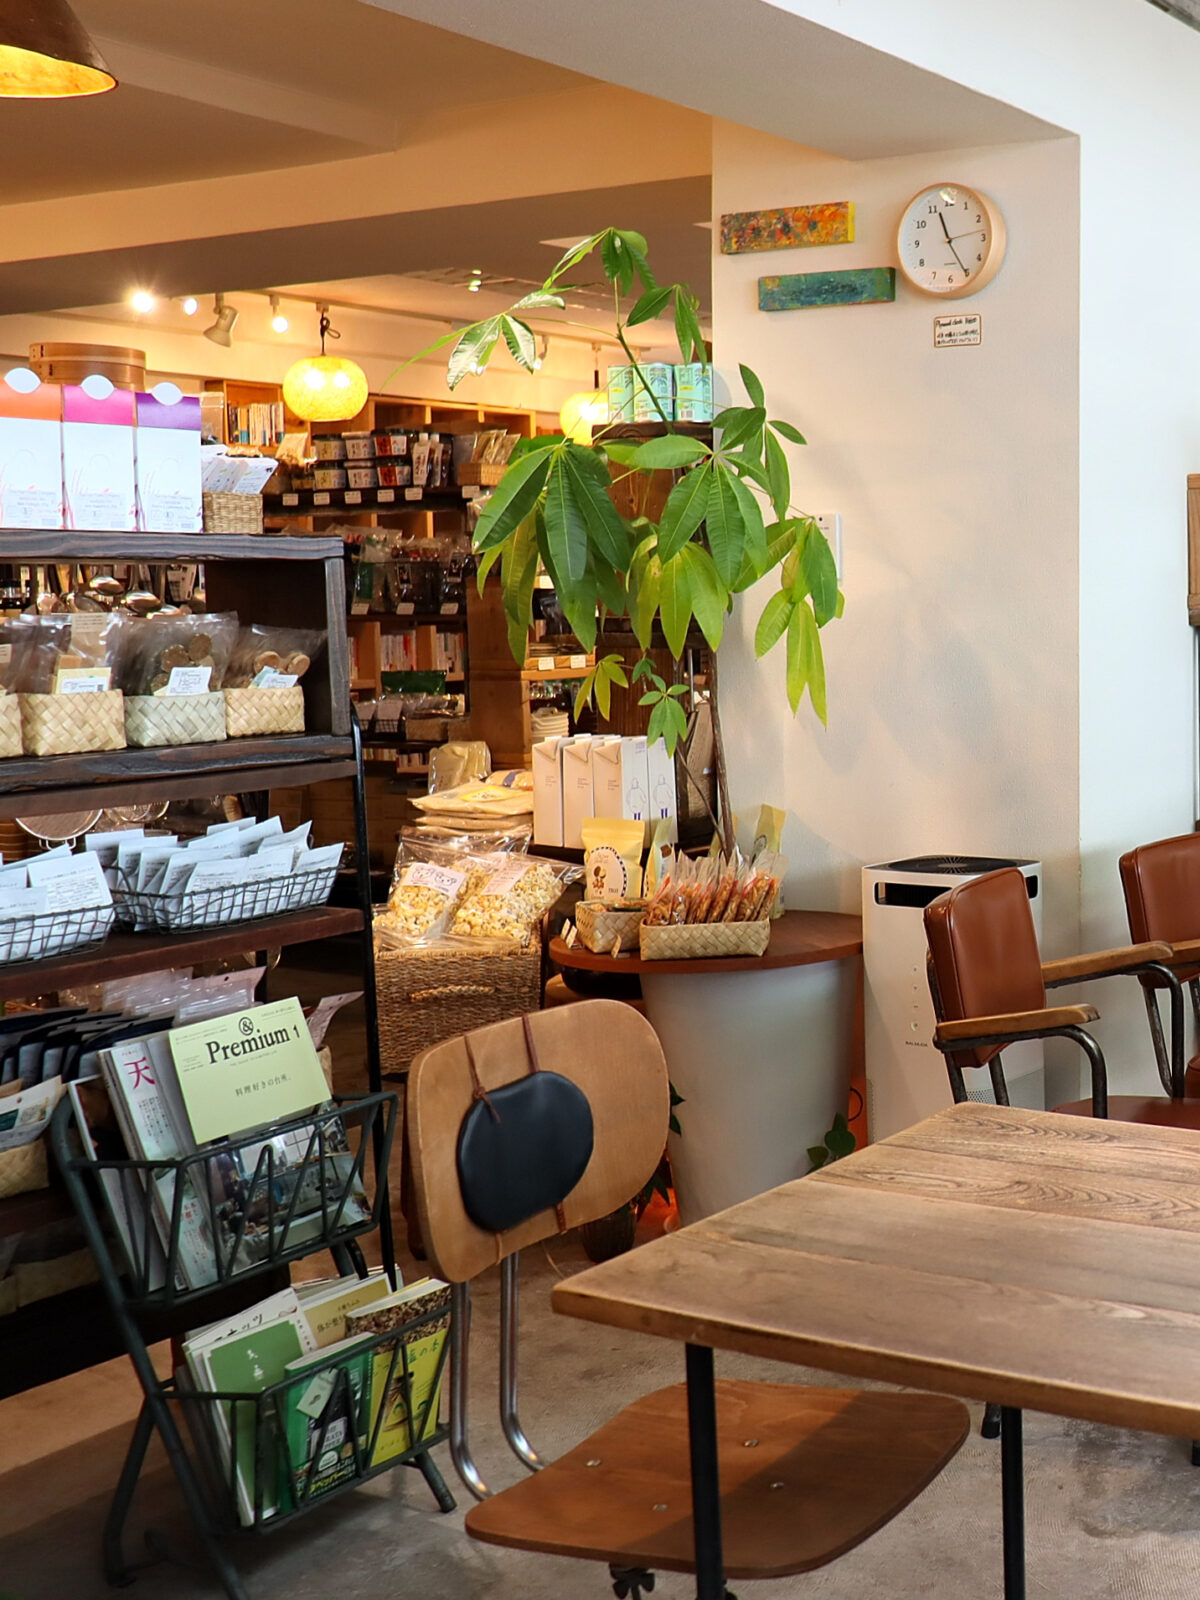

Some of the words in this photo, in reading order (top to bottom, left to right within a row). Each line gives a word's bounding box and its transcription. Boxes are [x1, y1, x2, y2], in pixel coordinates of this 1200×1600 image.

[928, 205, 937, 214] 11
[963, 201, 969, 210] 1
[976, 214, 982, 223] 2
[916, 220, 927, 229] 10
[981, 233, 986, 242] 3
[914, 240, 920, 248] 9
[976, 253, 982, 262] 4
[918, 258, 925, 267] 8
[932, 271, 937, 280] 7
[948, 274, 954, 284] 6
[205, 1027, 291, 1065] Premium
[293, 1024, 301, 1039] 1
[123, 1056, 156, 1090] 天
